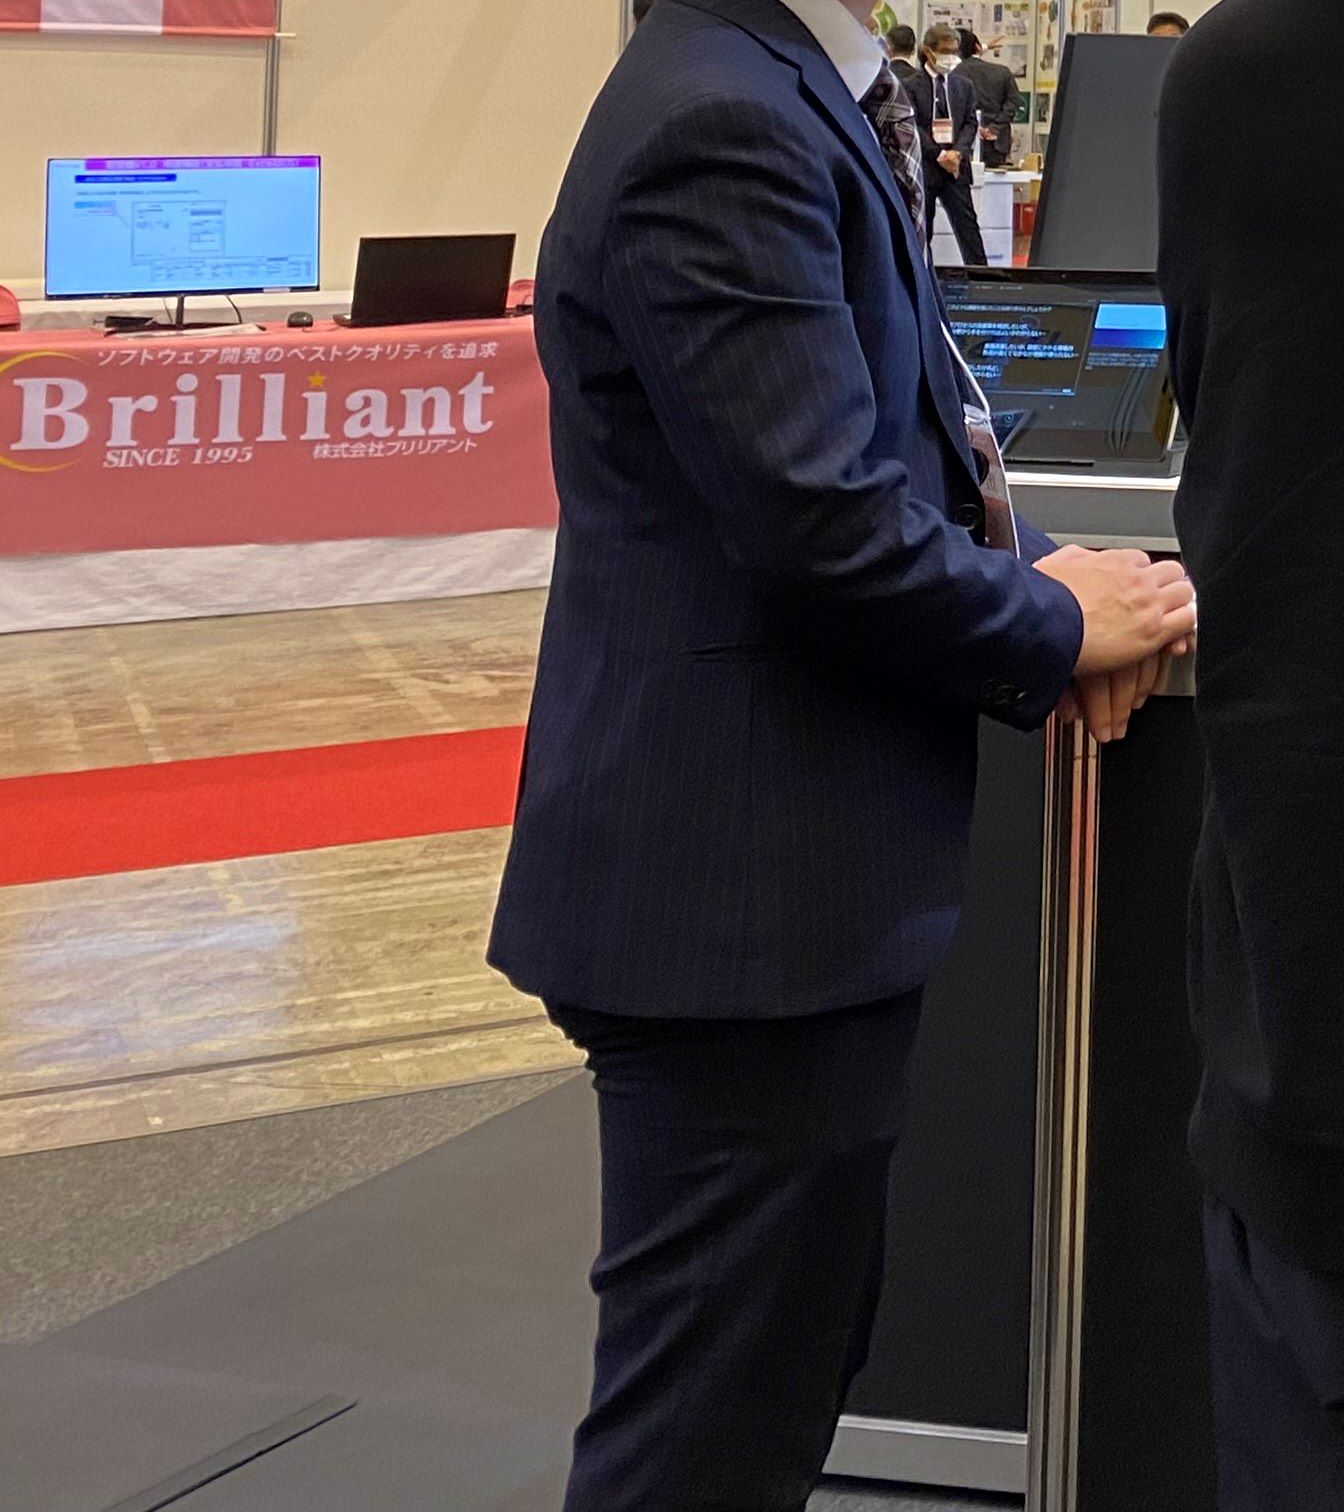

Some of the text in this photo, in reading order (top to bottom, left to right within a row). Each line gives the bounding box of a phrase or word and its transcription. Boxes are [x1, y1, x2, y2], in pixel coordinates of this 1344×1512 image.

[97, 342, 498, 366] ソフトウェア開発のベストクオリティを追求
[11, 371, 495, 451] Brilliant
[103, 447, 253, 467] SINCE 1995
